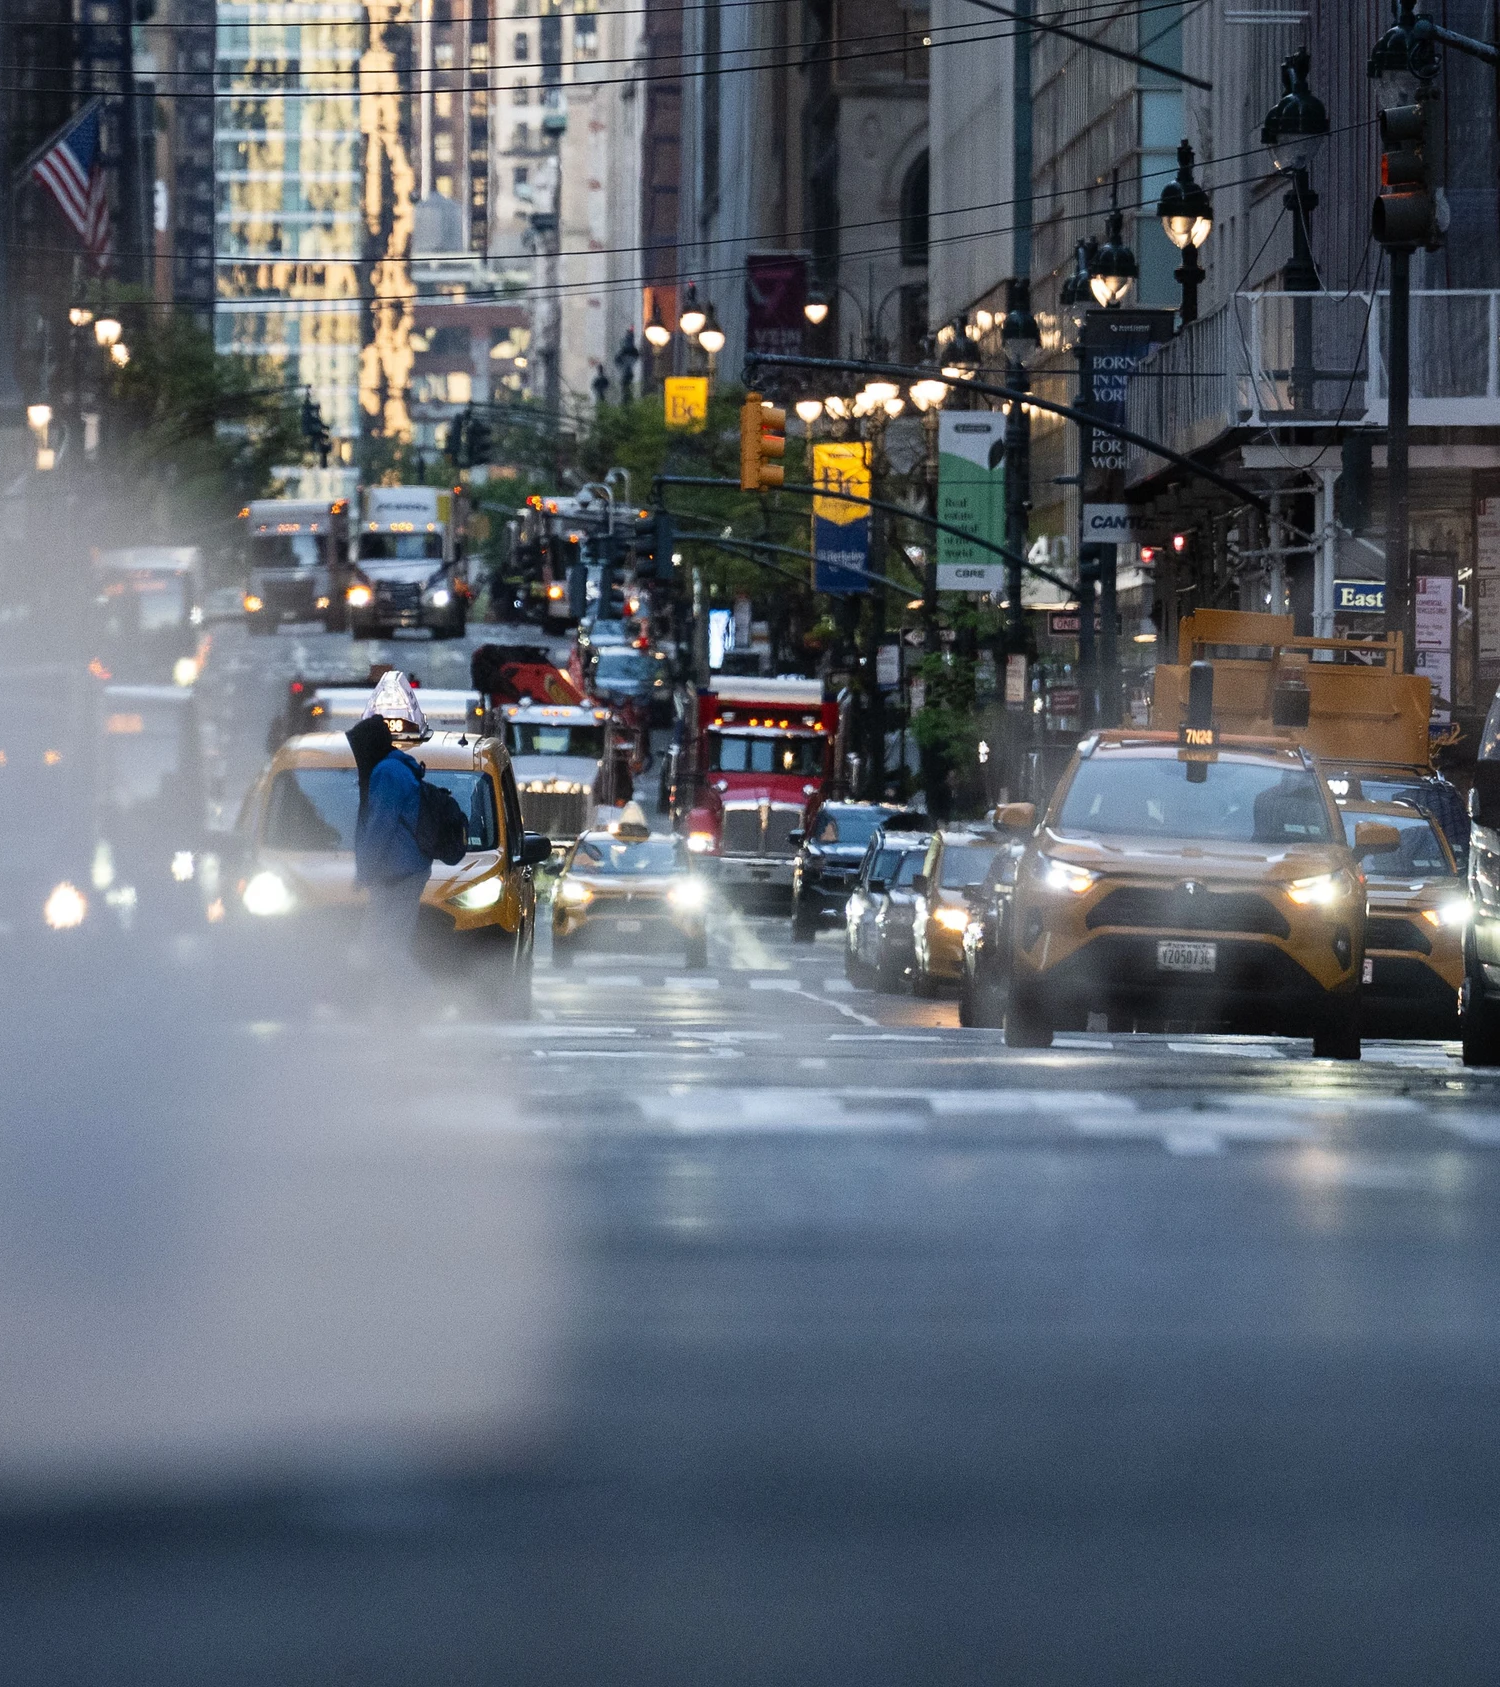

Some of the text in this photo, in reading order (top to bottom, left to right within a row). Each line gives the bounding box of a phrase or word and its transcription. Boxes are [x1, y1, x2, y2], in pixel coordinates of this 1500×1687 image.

[1092, 356, 1137, 370] BORN
[1091, 440, 1122, 454] FOR
[955, 568, 985, 579] CBRE
[1340, 587, 1384, 608] East
[1416, 652, 1424, 667] 6
